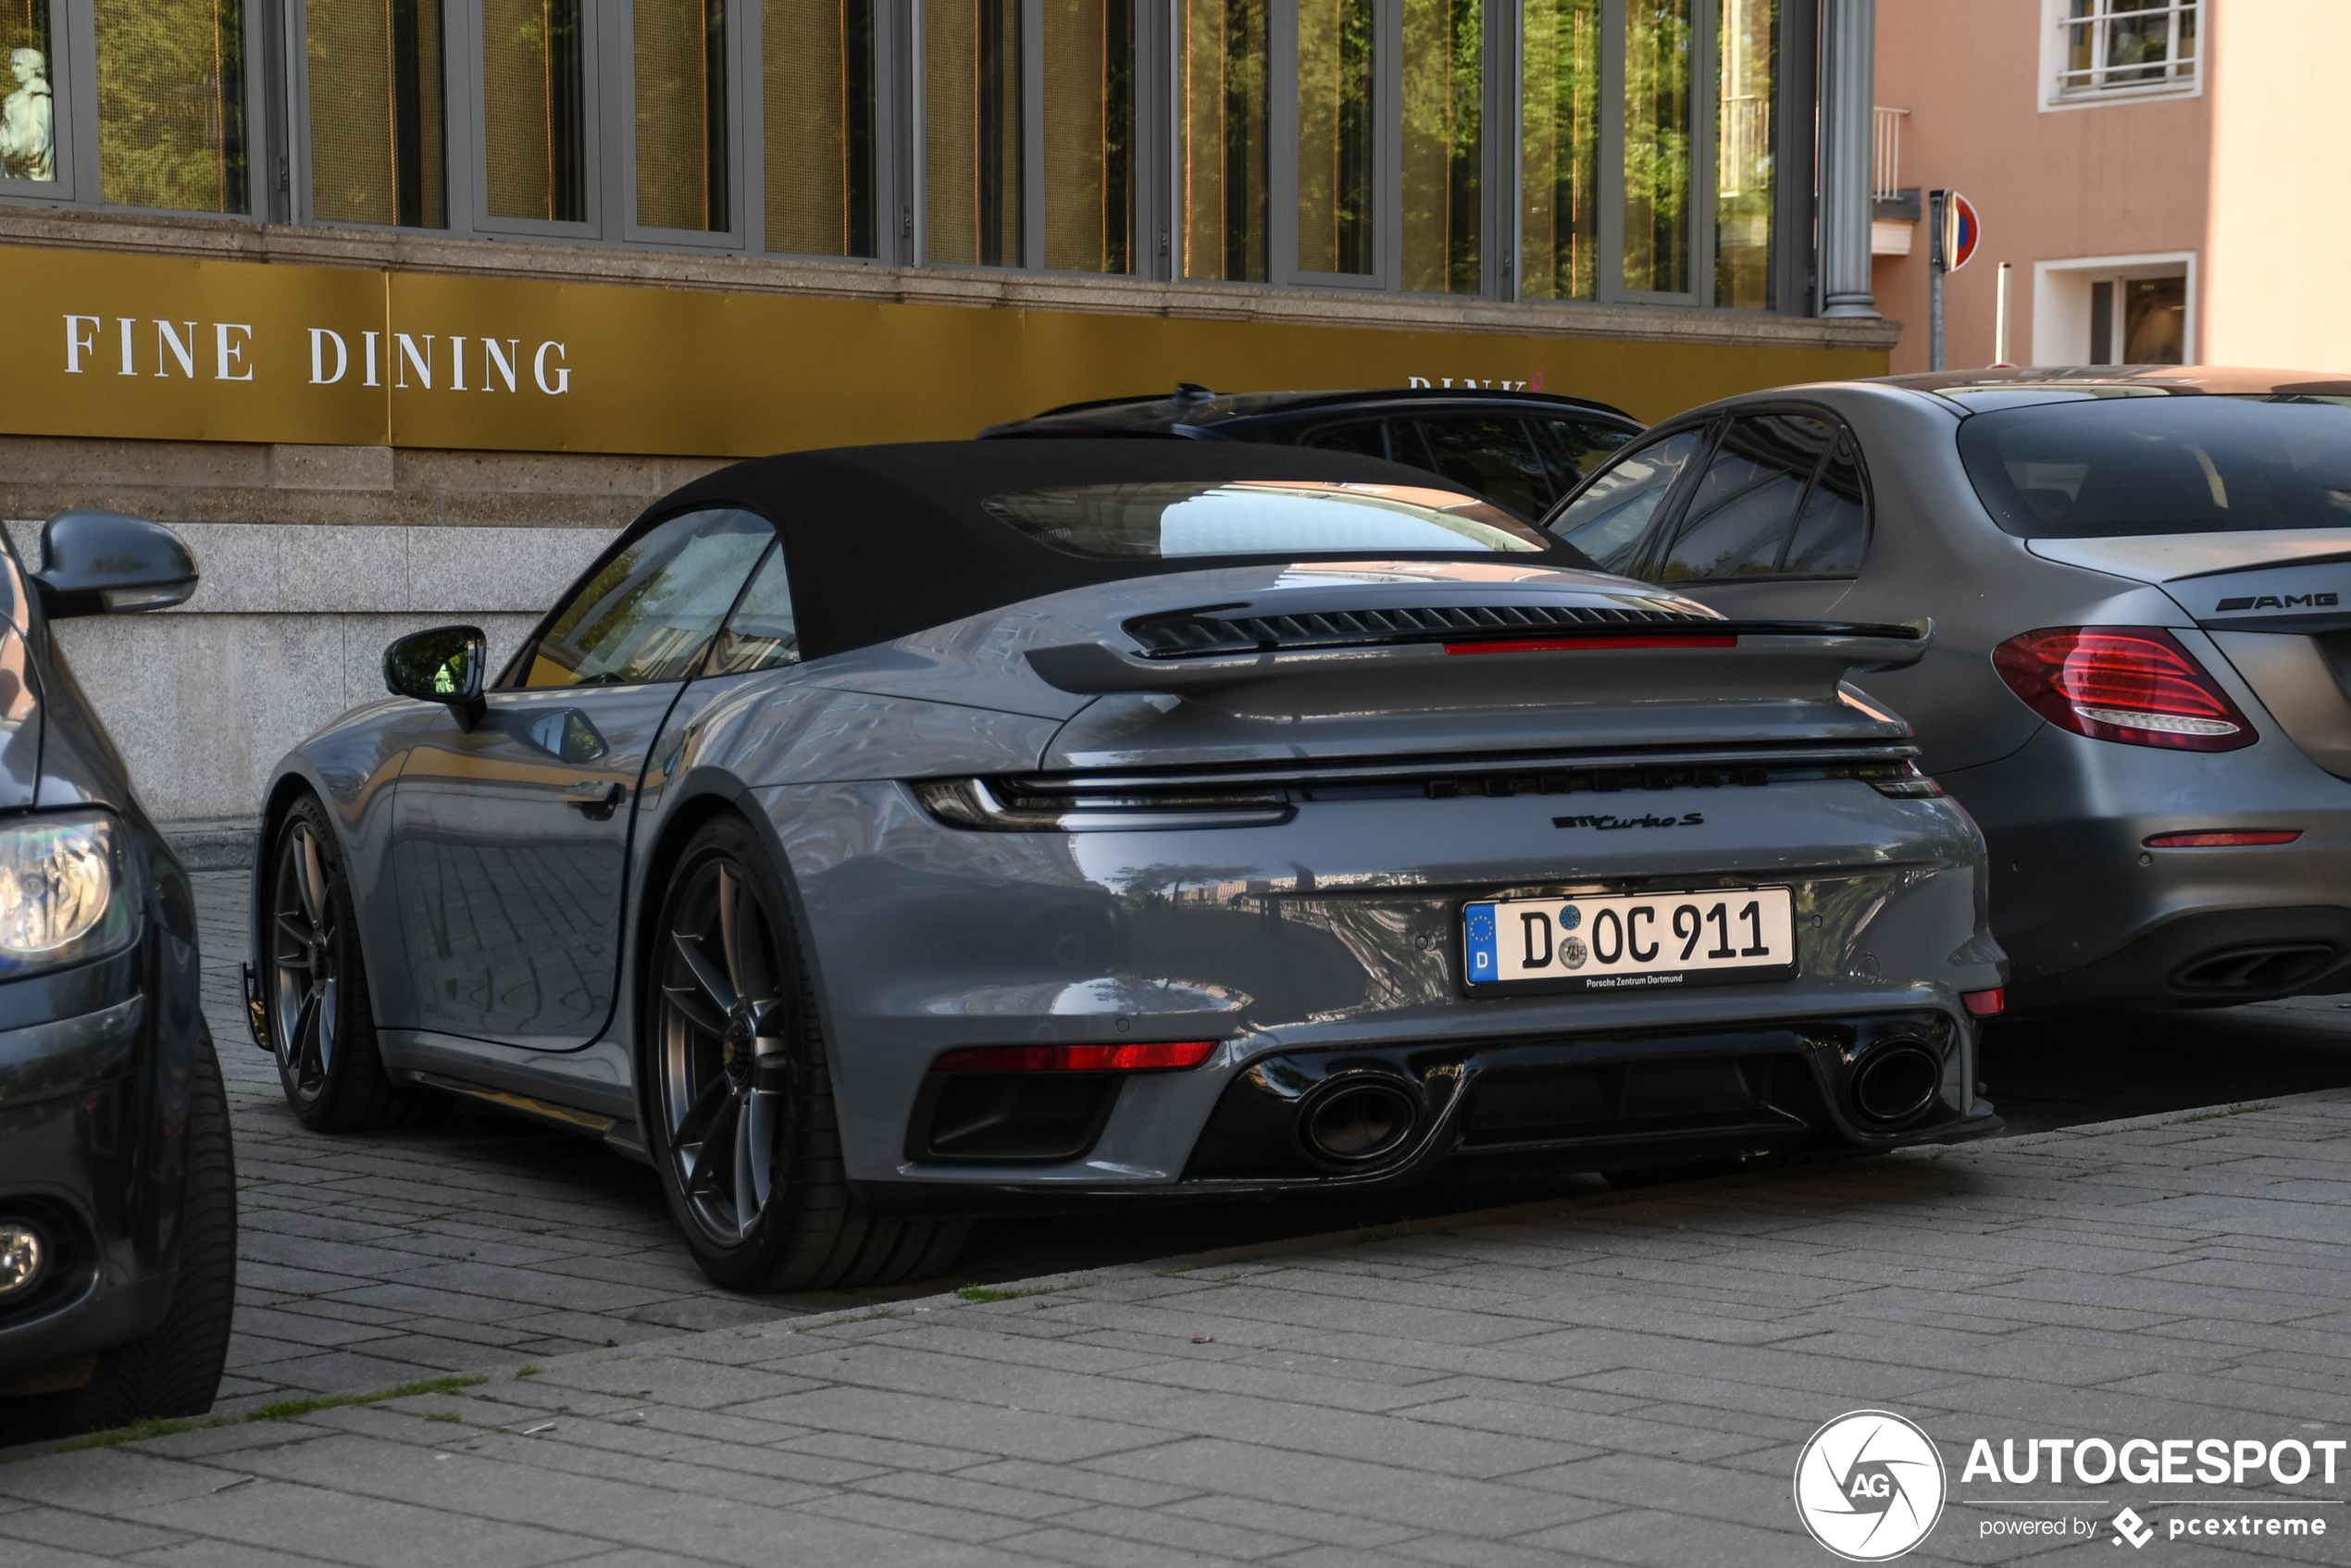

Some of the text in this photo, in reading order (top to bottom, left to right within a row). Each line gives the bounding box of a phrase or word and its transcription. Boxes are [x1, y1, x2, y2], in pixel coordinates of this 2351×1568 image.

[62, 314, 571, 395] FINE DINING
[2254, 592, 2339, 609] AMG
[1678, 813, 1704, 827] S
[1520, 901, 1770, 969] D OC 911
[1476, 952, 1488, 968] D
[1586, 974, 1683, 988] Porsche Zentrum Dortmund
